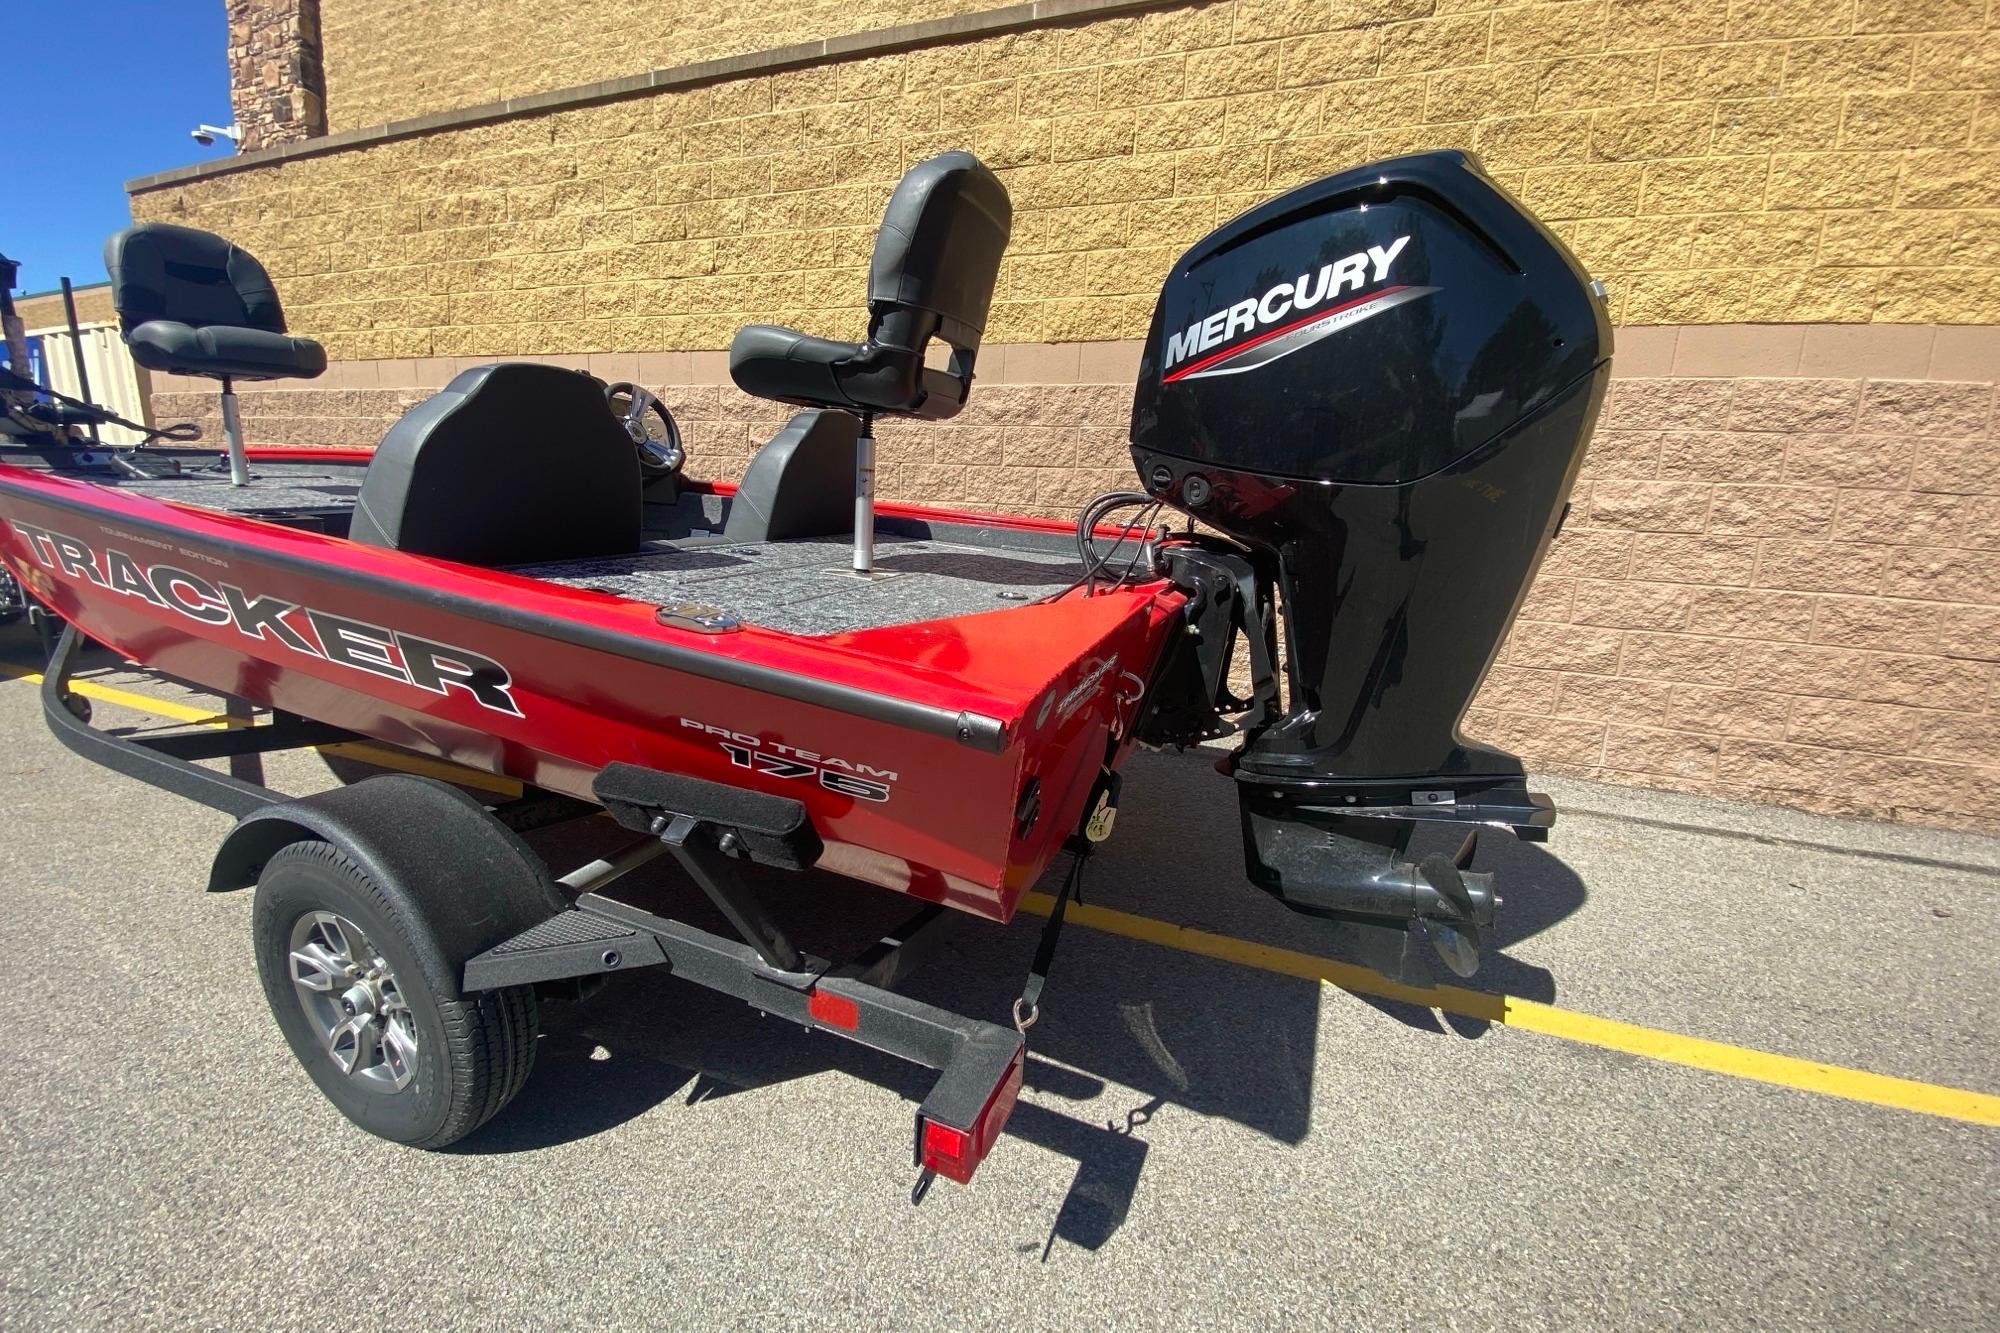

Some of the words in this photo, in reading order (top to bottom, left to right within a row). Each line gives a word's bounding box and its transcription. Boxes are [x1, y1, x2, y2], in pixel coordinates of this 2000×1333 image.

[1165, 235, 1411, 369] MERCURY
[1285, 301, 1377, 342] FOURSTROKE
[99, 526, 174, 552] TOURNAMENT
[179, 547, 229, 569] EDITION
[10, 518, 526, 719] TRACKER
[680, 717, 761, 747] PRO
[768, 741, 898, 782] TEAM
[718, 741, 891, 803] 175
